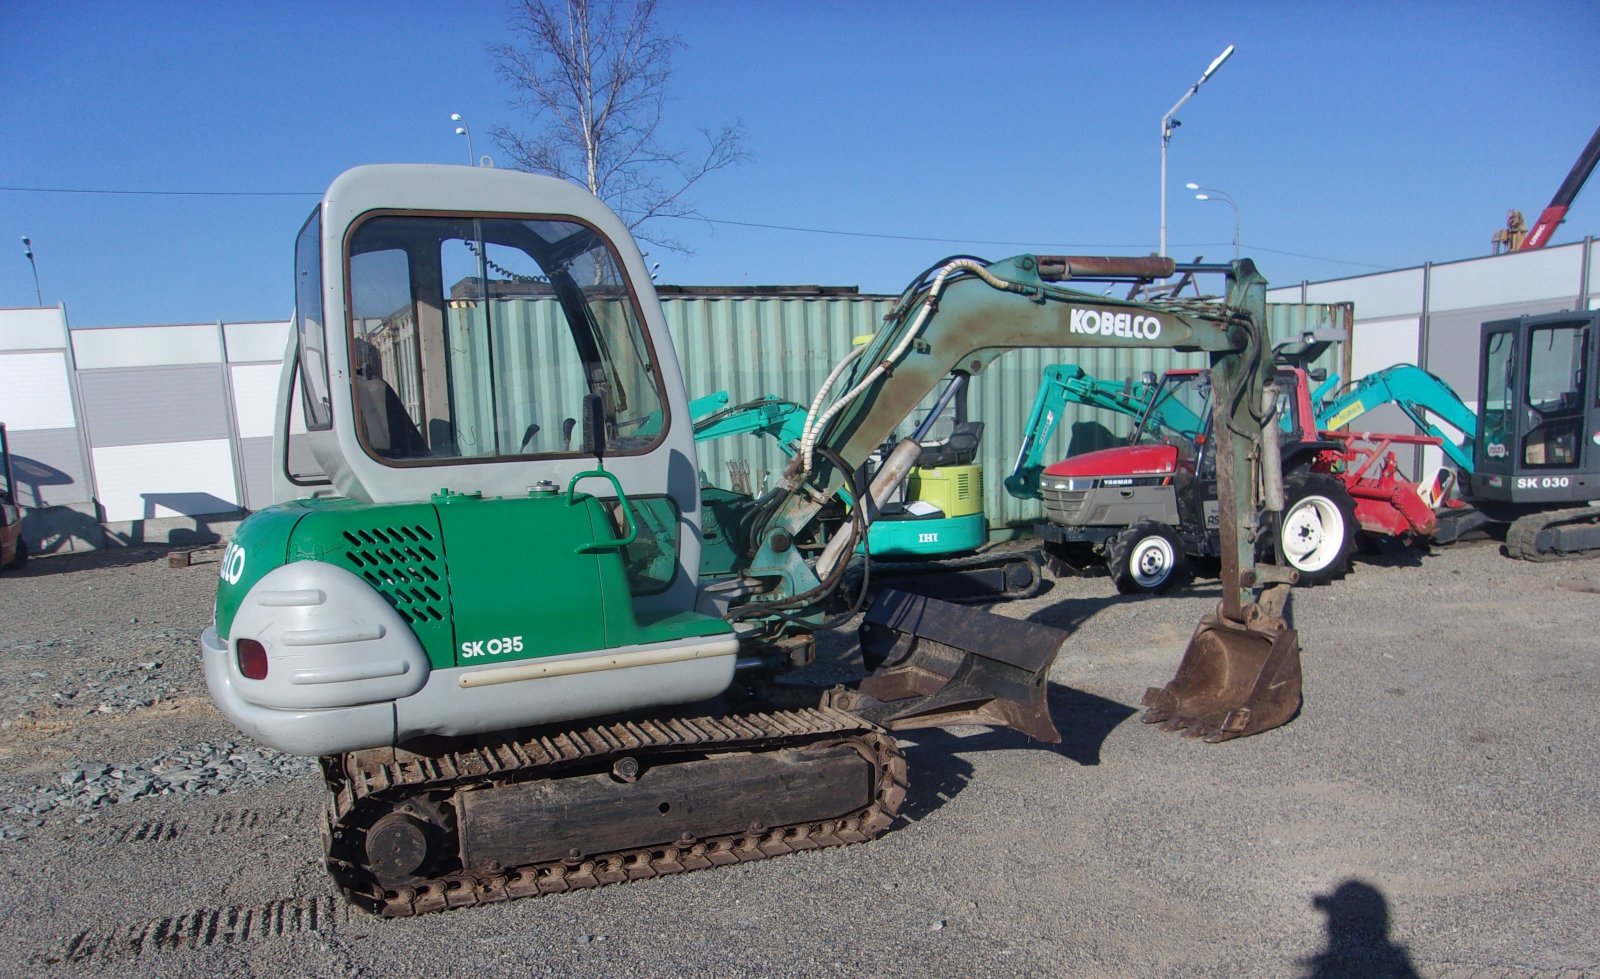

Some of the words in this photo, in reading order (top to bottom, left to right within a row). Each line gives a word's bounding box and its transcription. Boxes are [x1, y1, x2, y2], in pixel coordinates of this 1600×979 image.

[1069, 308, 1161, 340] KOBELCO
[1517, 478, 1538, 488] SK
[1541, 477, 1569, 488] 030
[918, 533, 938, 543] IHI
[461, 640, 486, 658] SK
[486, 635, 524, 655] 035
